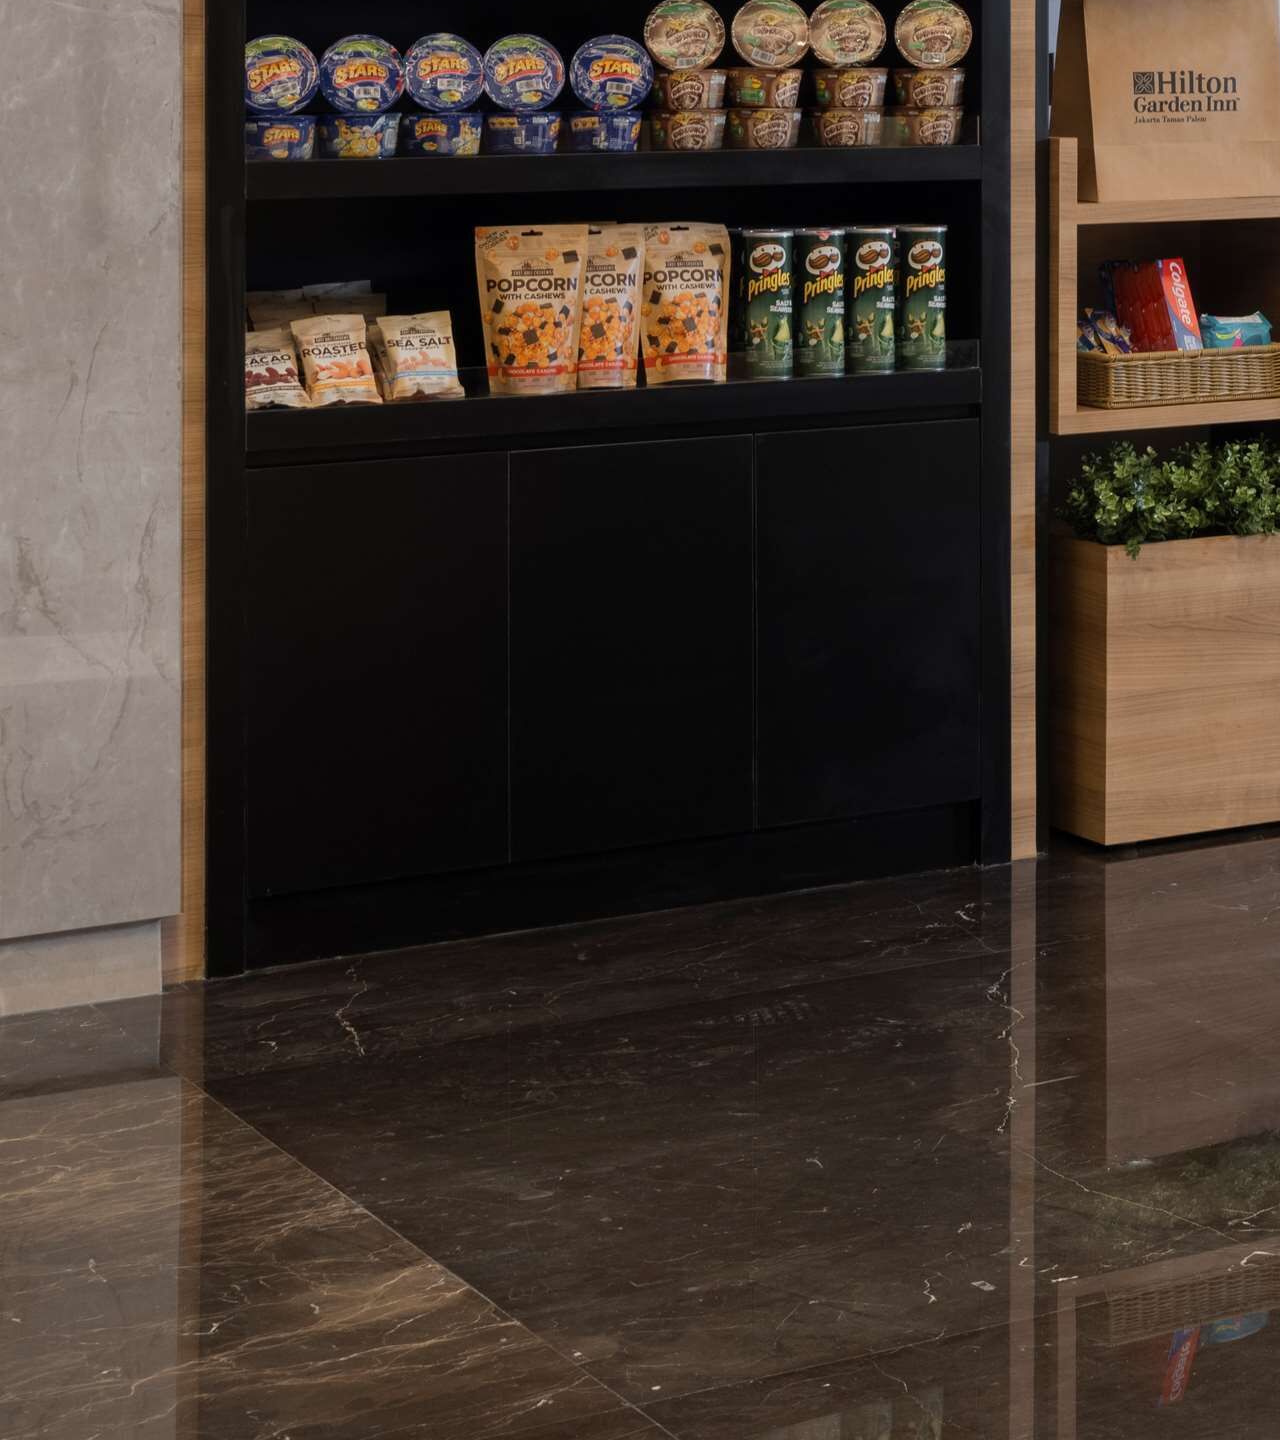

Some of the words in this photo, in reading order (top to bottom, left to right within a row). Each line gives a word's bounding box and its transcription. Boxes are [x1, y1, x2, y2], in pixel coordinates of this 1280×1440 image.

[248, 59, 301, 88] STARS
[335, 62, 387, 85] STARS
[419, 55, 468, 77] STARS
[495, 57, 546, 83] STARS
[590, 57, 642, 78] STARS
[1157, 70, 1237, 95] Hilton
[1134, 96, 1202, 113] Garden
[1134, 116, 1161, 124] Jakarta
[486, 277, 577, 293] POPCORN
[643, 269, 723, 285] POPCORN
[657, 283, 677, 291] WITH
[679, 281, 716, 291] CASHEWS
[748, 269, 790, 302] Pringles
[804, 270, 844, 304] Pringles
[853, 266, 894, 299] Pringles
[906, 266, 946, 298] Pringles
[524, 291, 566, 300] CASHEWS
[1169, 261, 1192, 326] Colgate
[387, 338, 413, 348] SEA
[419, 336, 452, 347] SALT
[246, 353, 292, 366] ACAO
